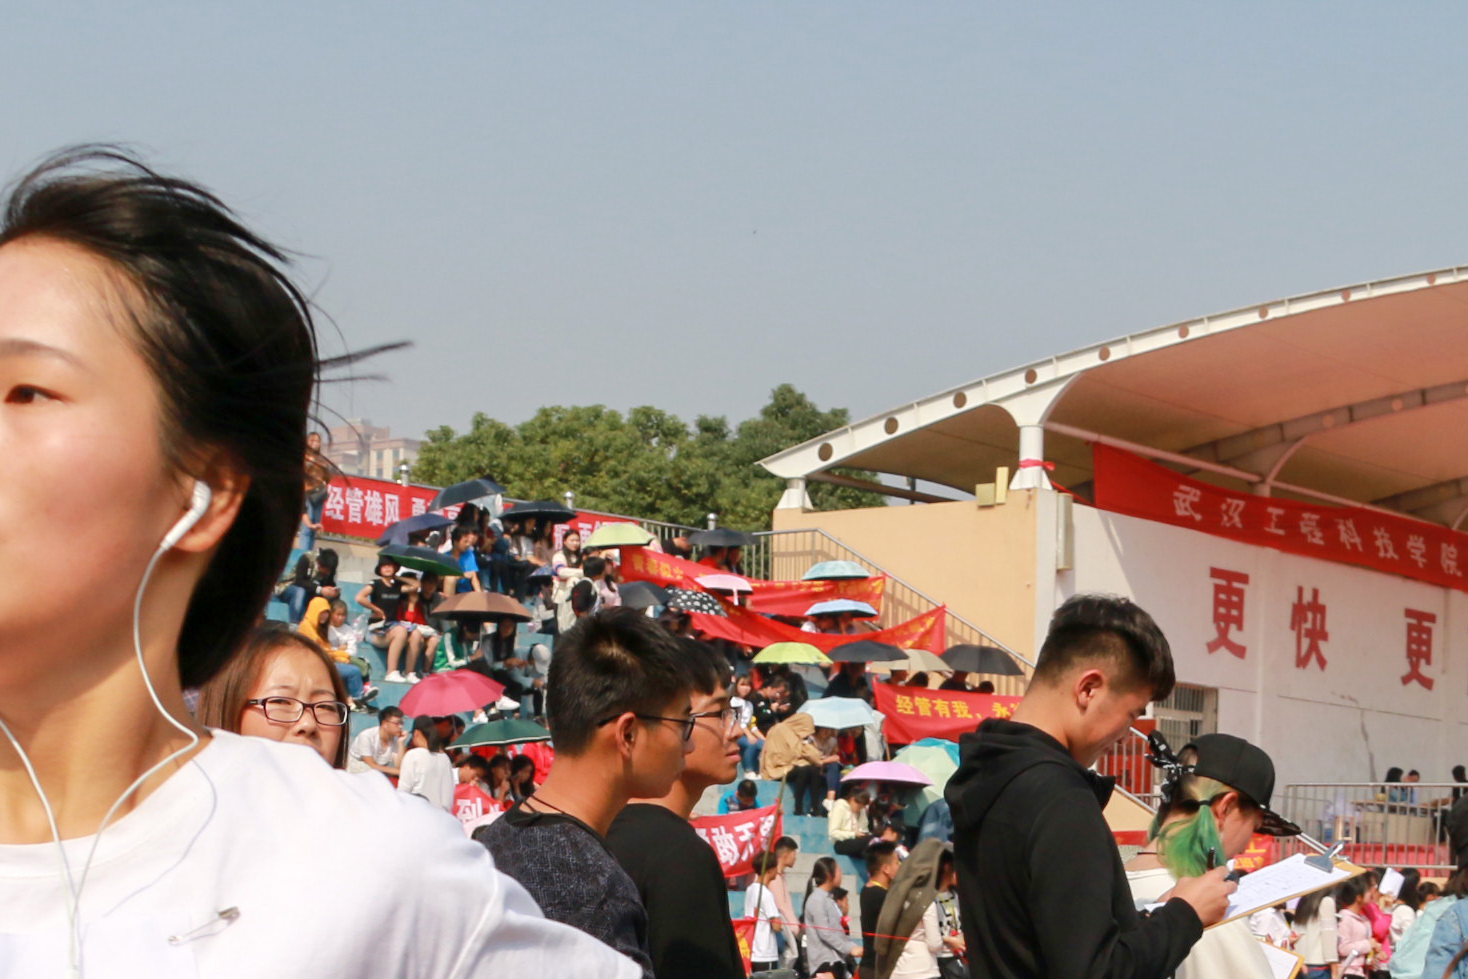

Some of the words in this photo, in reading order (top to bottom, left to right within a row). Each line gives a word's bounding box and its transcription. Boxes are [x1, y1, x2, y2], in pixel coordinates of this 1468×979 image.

[325, 484, 400, 527] 经管雄风
[1173, 484, 1463, 577] 武汉工程科技学院
[1400, 607, 1437, 691] 更
